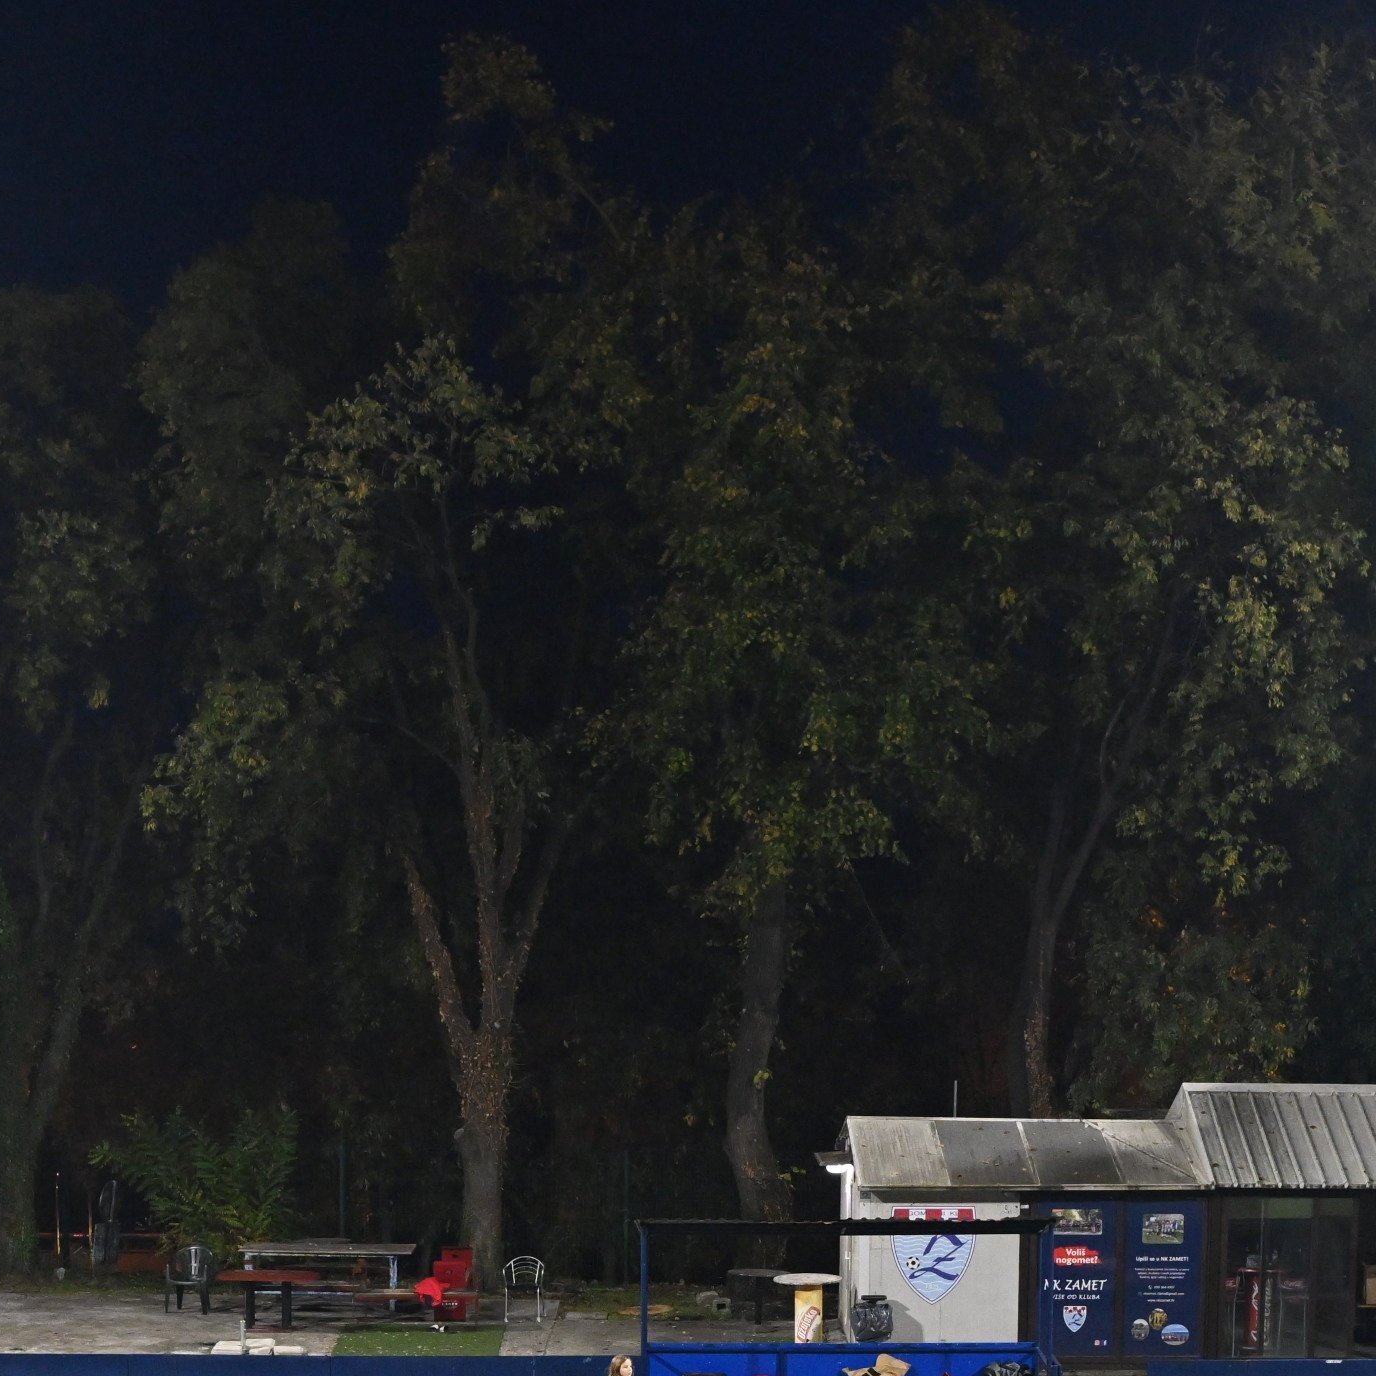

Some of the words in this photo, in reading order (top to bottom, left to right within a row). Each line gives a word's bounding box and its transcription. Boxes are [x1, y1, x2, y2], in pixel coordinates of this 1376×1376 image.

[1065, 1248, 1086, 1256] Voliš
[1055, 1255, 1099, 1266] nogomet?
[1043, 1278, 1061, 1291] NK
[1064, 1278, 1108, 1291] ZAMET
